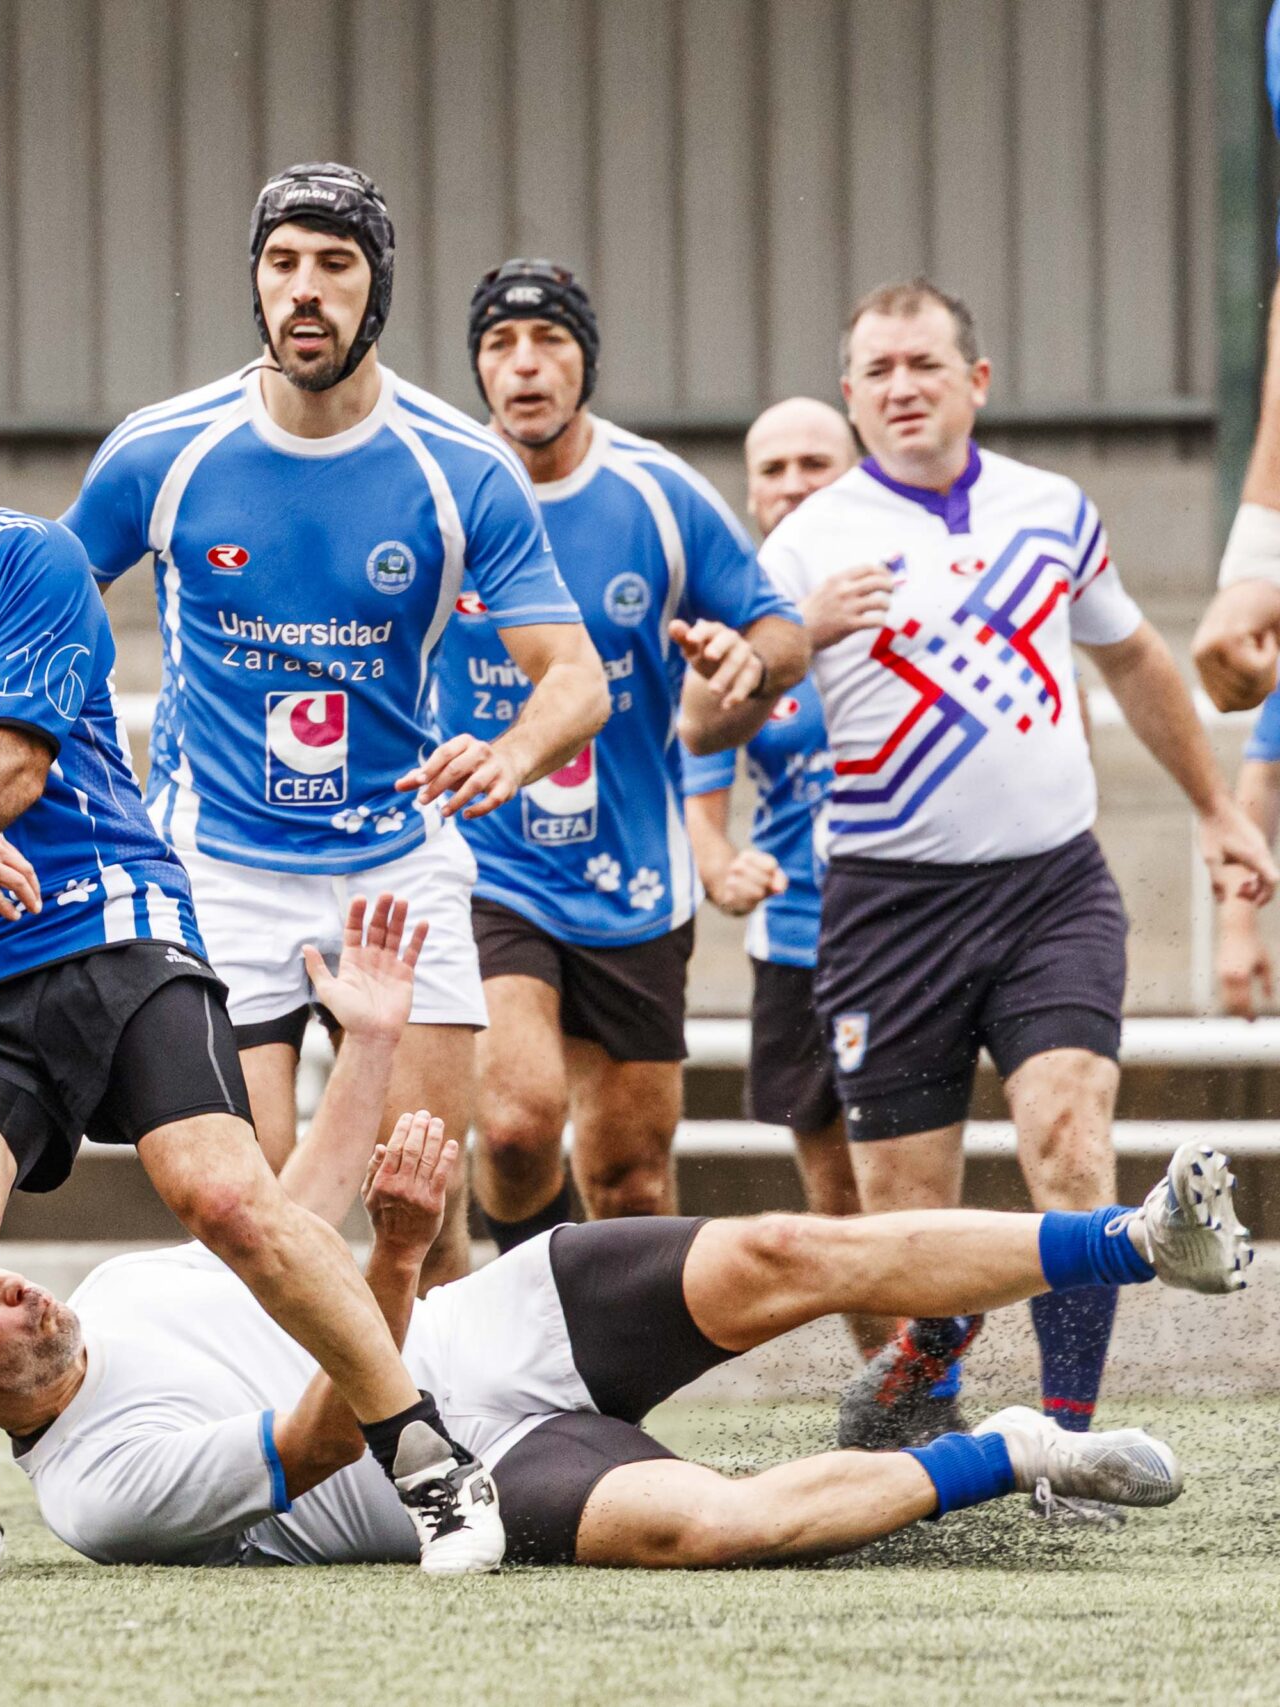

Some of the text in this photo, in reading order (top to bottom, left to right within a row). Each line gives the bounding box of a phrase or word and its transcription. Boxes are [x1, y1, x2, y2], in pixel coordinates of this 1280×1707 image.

[218, 610, 392, 647] Universidad
[222, 642, 385, 681] Zaragoza
[274, 778, 339, 800] CEFA
[531, 817, 588, 838] CEFA
